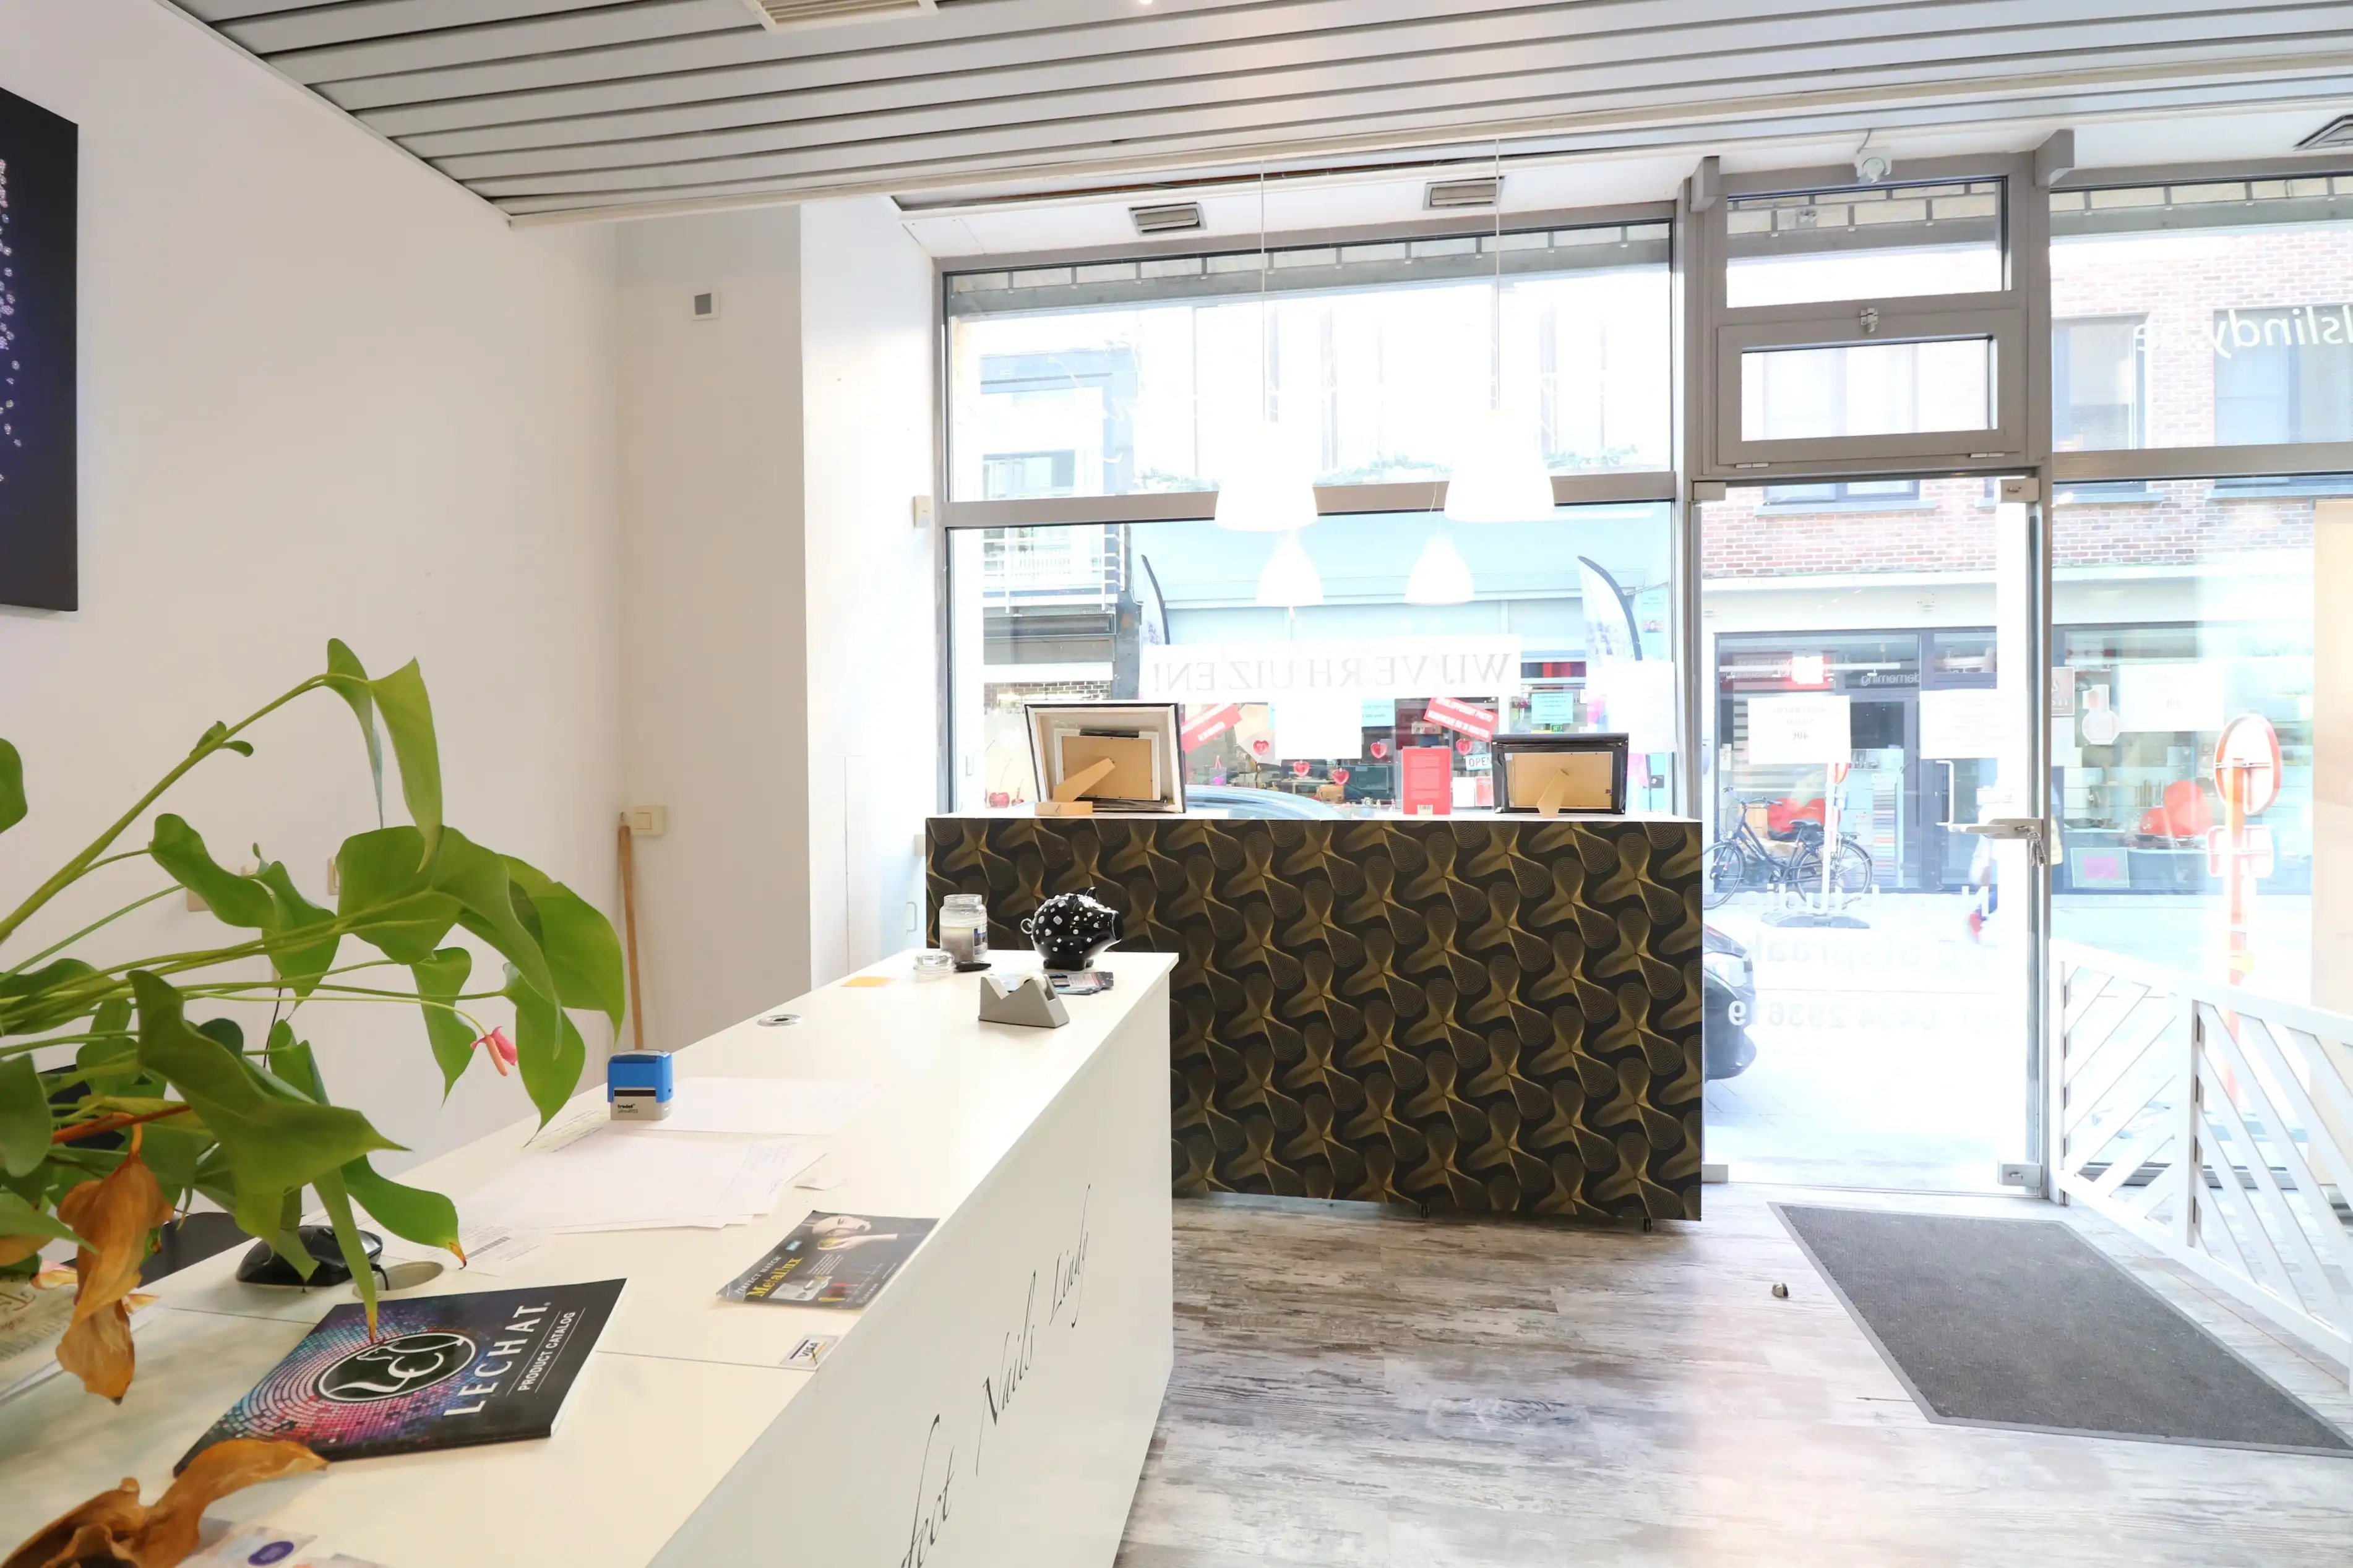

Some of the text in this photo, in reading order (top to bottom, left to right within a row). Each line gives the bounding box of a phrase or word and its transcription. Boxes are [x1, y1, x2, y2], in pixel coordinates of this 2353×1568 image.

[746, 1256, 804, 1298] Metallux
[443, 1303, 549, 1416] LECHAT
[517, 1311, 577, 1392] PRODUCT CATALOG
[976, 1269, 1037, 1476] Nails
[1049, 1183, 1091, 1328] Lindy
